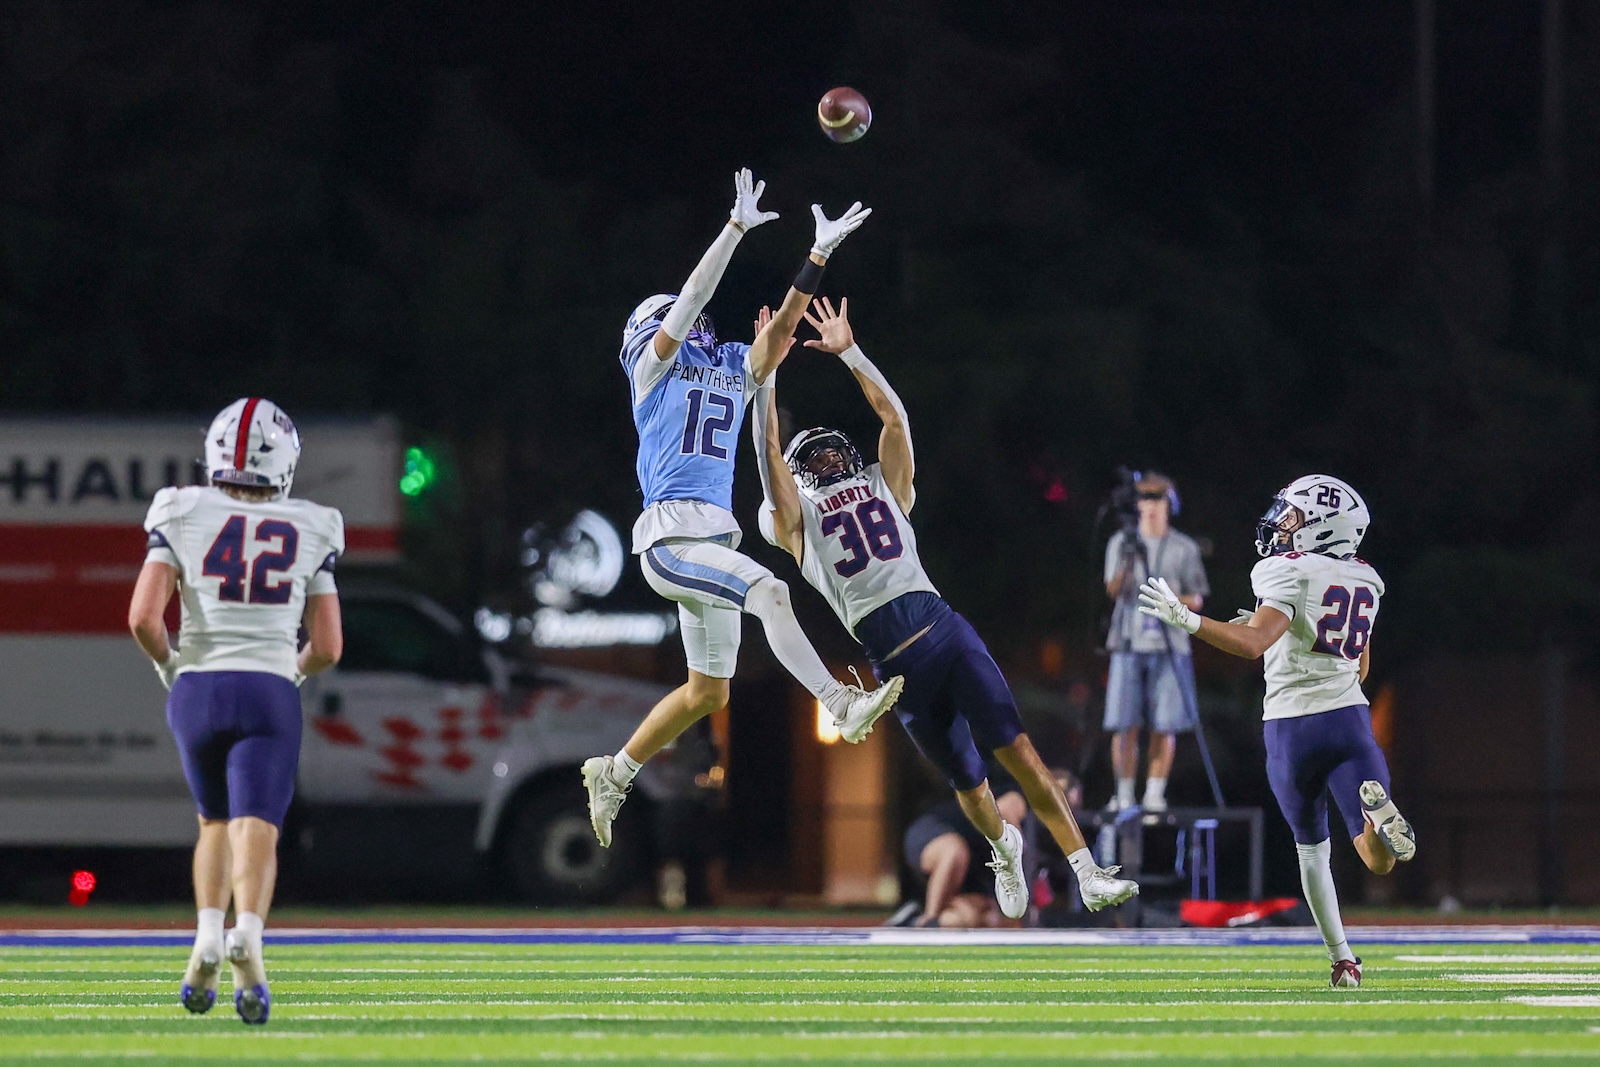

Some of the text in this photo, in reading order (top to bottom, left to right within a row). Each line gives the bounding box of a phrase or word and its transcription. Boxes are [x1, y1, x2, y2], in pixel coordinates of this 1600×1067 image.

[670, 362, 743, 392] PANTHERS
[679, 387, 736, 461] 12
[816, 484, 874, 514] LIBERTY
[1316, 485, 1341, 508] 26
[202, 515, 299, 604] 42
[821, 496, 904, 579] 38
[1310, 585, 1374, 660] 26
